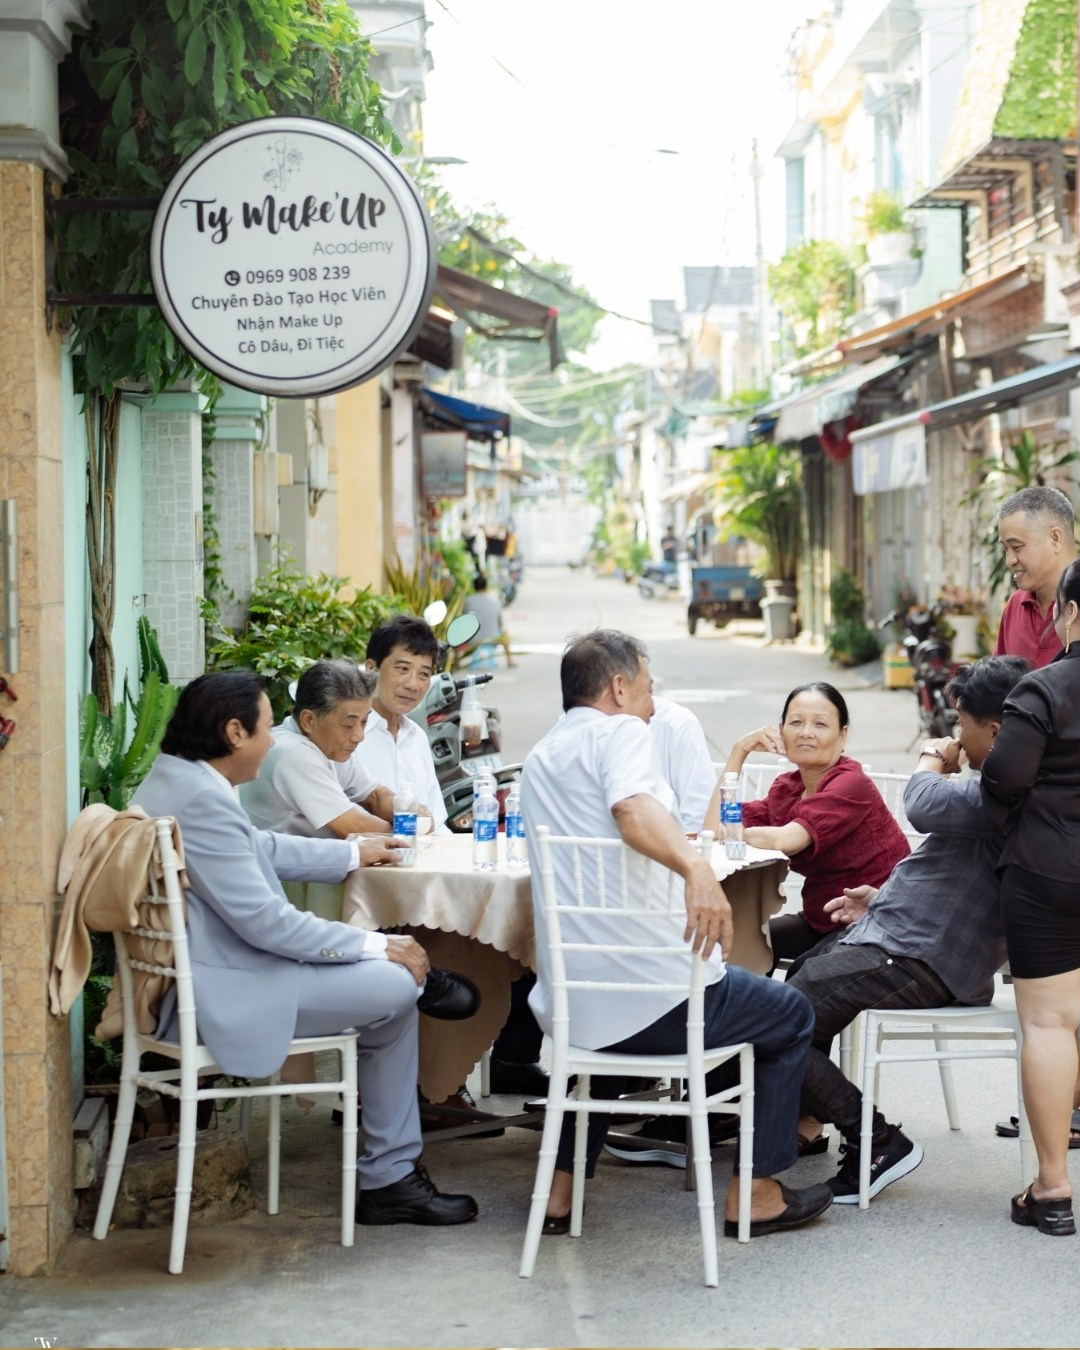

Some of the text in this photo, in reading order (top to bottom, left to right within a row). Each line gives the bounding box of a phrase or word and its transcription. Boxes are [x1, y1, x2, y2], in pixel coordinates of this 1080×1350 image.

[180, 198, 232, 244] Ty
[312, 240, 394, 256] Academy
[246, 265, 350, 284] 0969 908 239
[192, 286, 386, 311] Chuyên Đào Tạo Học Viên
[237, 313, 343, 332] Nhận Make Up
[238, 336, 345, 354] Cô Dâu, Đi Tiệc
